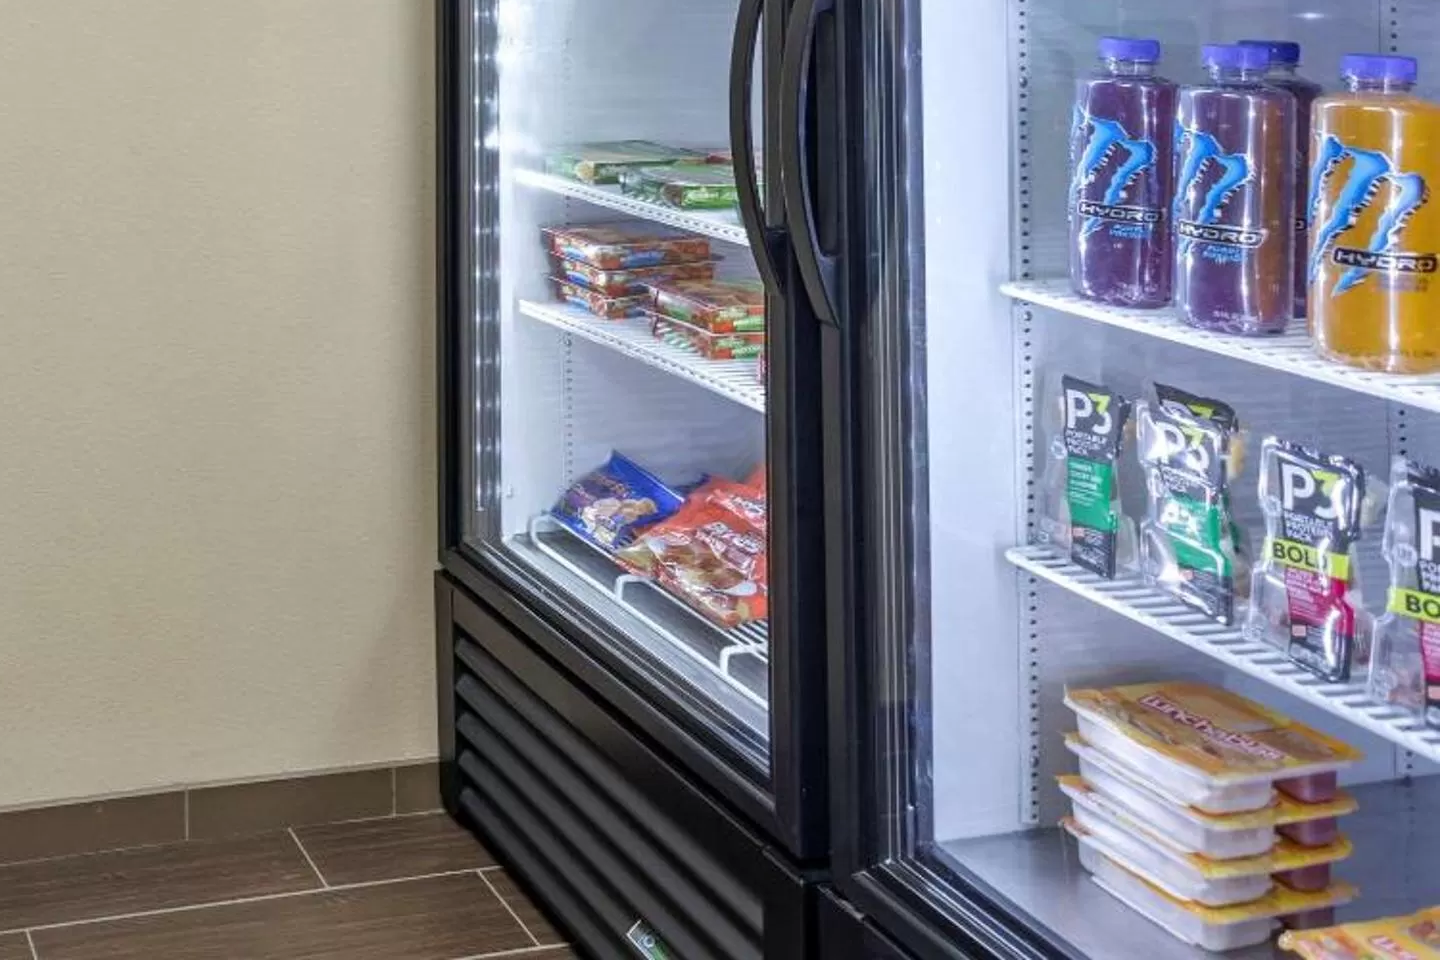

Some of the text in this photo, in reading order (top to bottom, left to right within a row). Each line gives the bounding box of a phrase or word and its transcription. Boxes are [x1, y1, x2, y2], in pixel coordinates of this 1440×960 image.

[1079, 205, 1160, 223] HYDRO
[1178, 222, 1259, 245] HYDRO
[1334, 251, 1437, 272] HYDRO
[1065, 388, 1113, 435] P3
[1152, 422, 1211, 472] P3
[1282, 462, 1346, 521] P3
